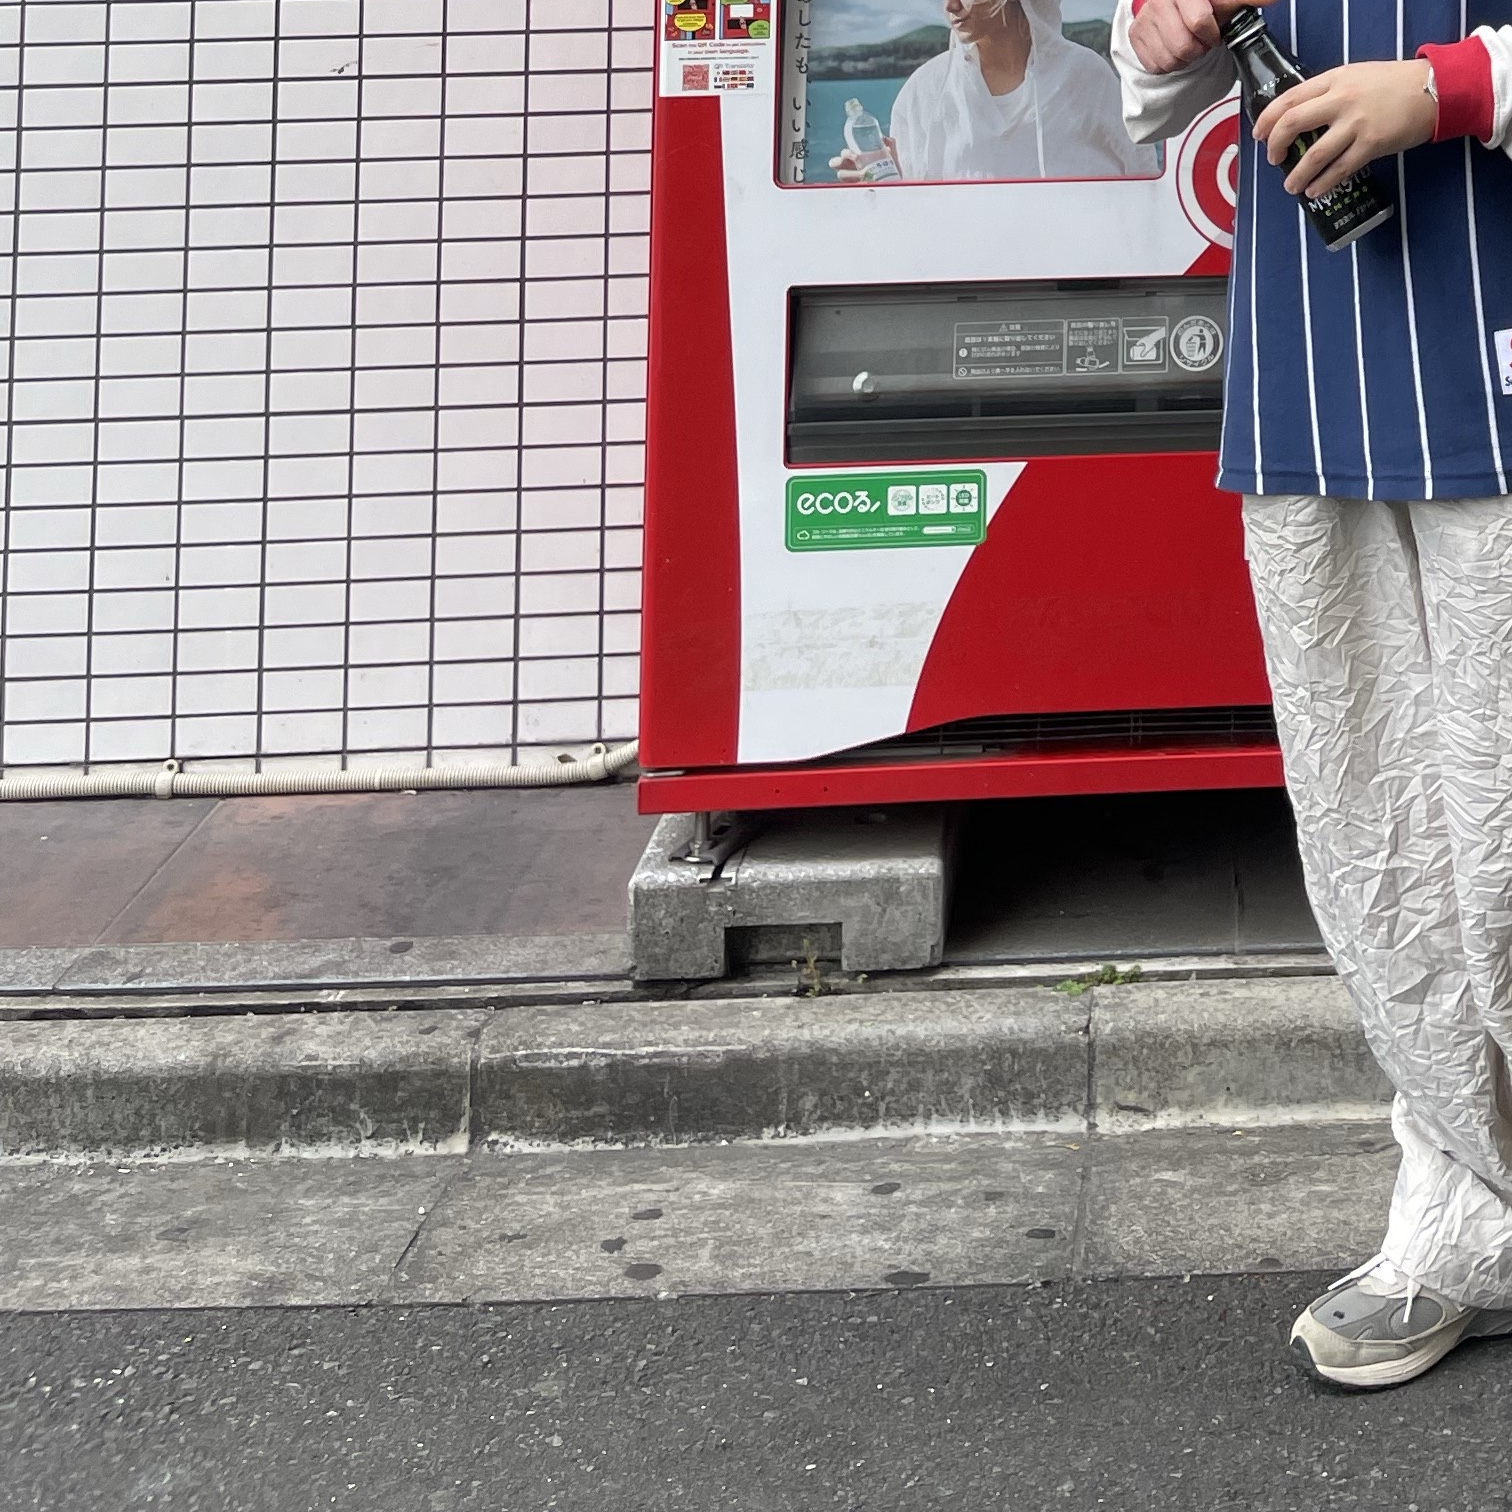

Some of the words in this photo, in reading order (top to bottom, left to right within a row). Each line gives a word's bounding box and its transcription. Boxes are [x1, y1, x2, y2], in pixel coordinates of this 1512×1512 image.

[1179, 353, 1216, 369] リサイクル
